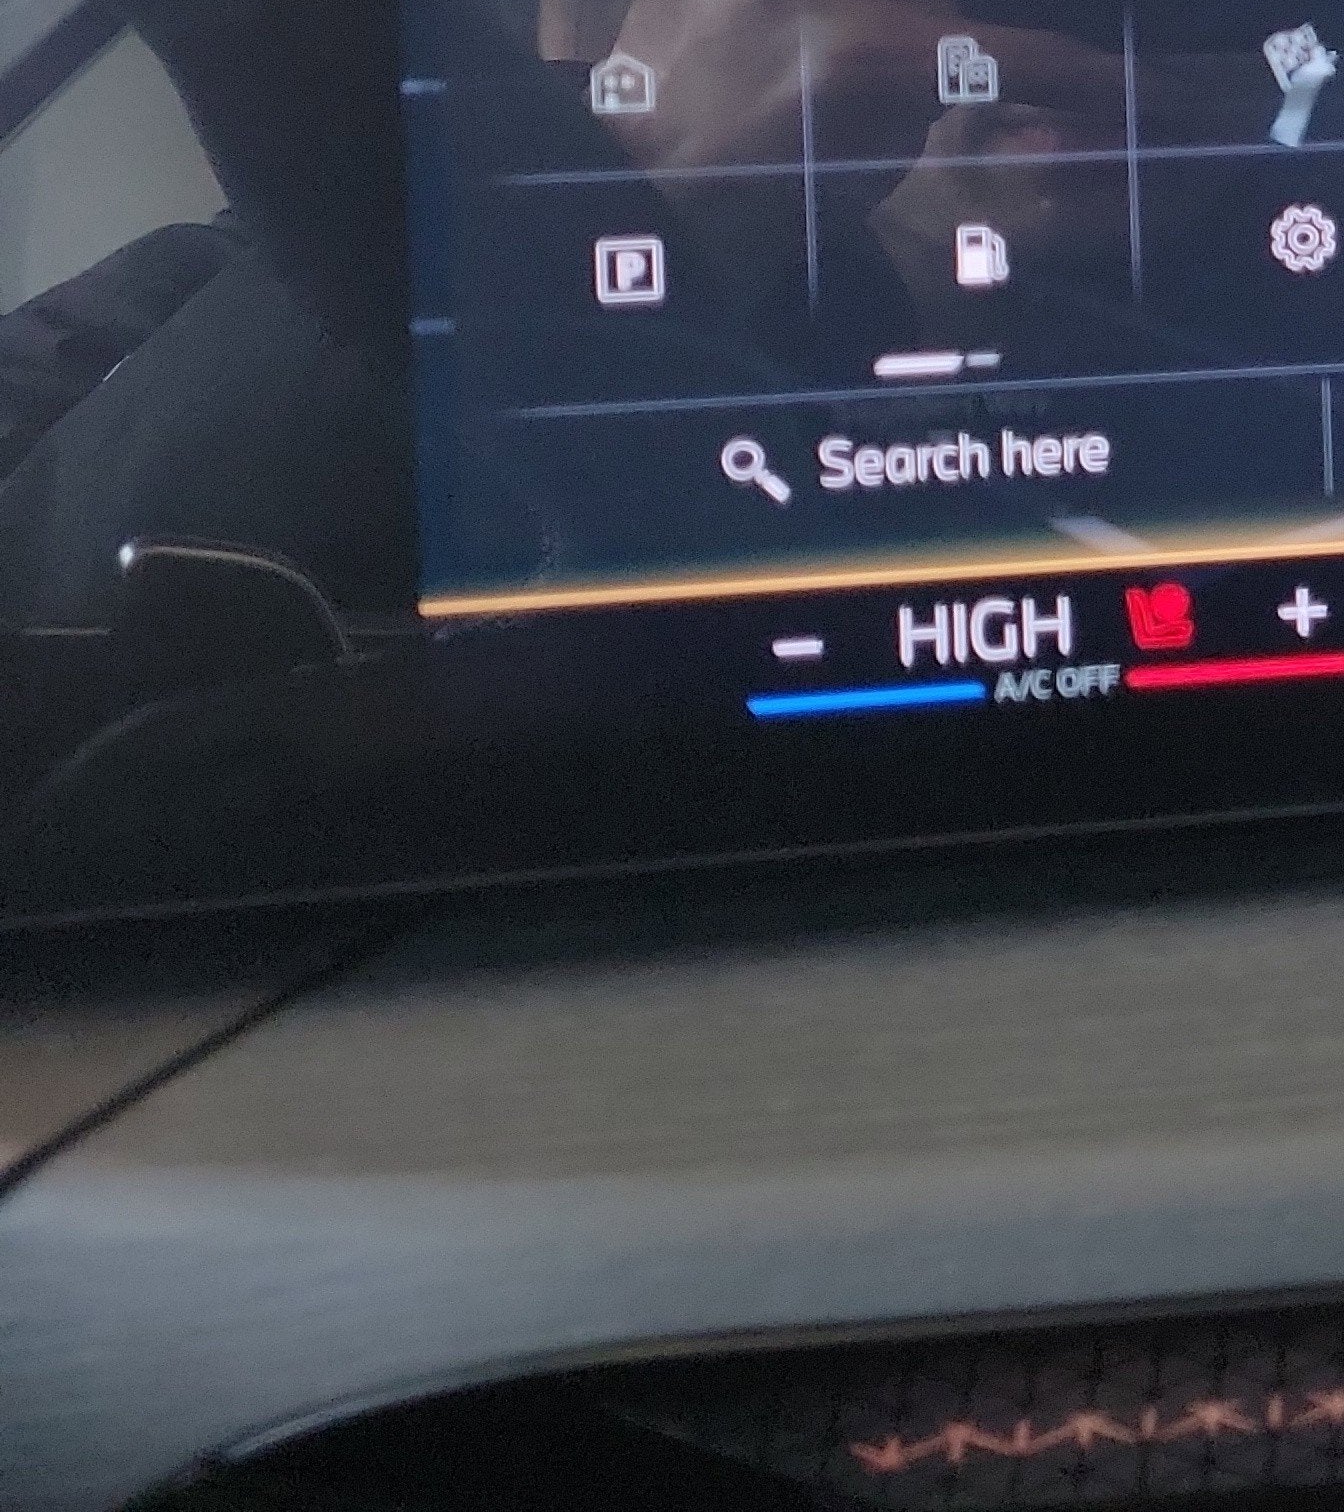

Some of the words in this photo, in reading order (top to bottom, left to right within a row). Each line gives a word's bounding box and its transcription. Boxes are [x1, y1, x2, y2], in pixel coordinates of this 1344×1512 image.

[819, 433, 990, 489] Search
[1002, 429, 1110, 478] here
[898, 594, 1074, 666] HIGH
[993, 669, 1052, 703] A/C
[1056, 664, 1120, 698] OFF
